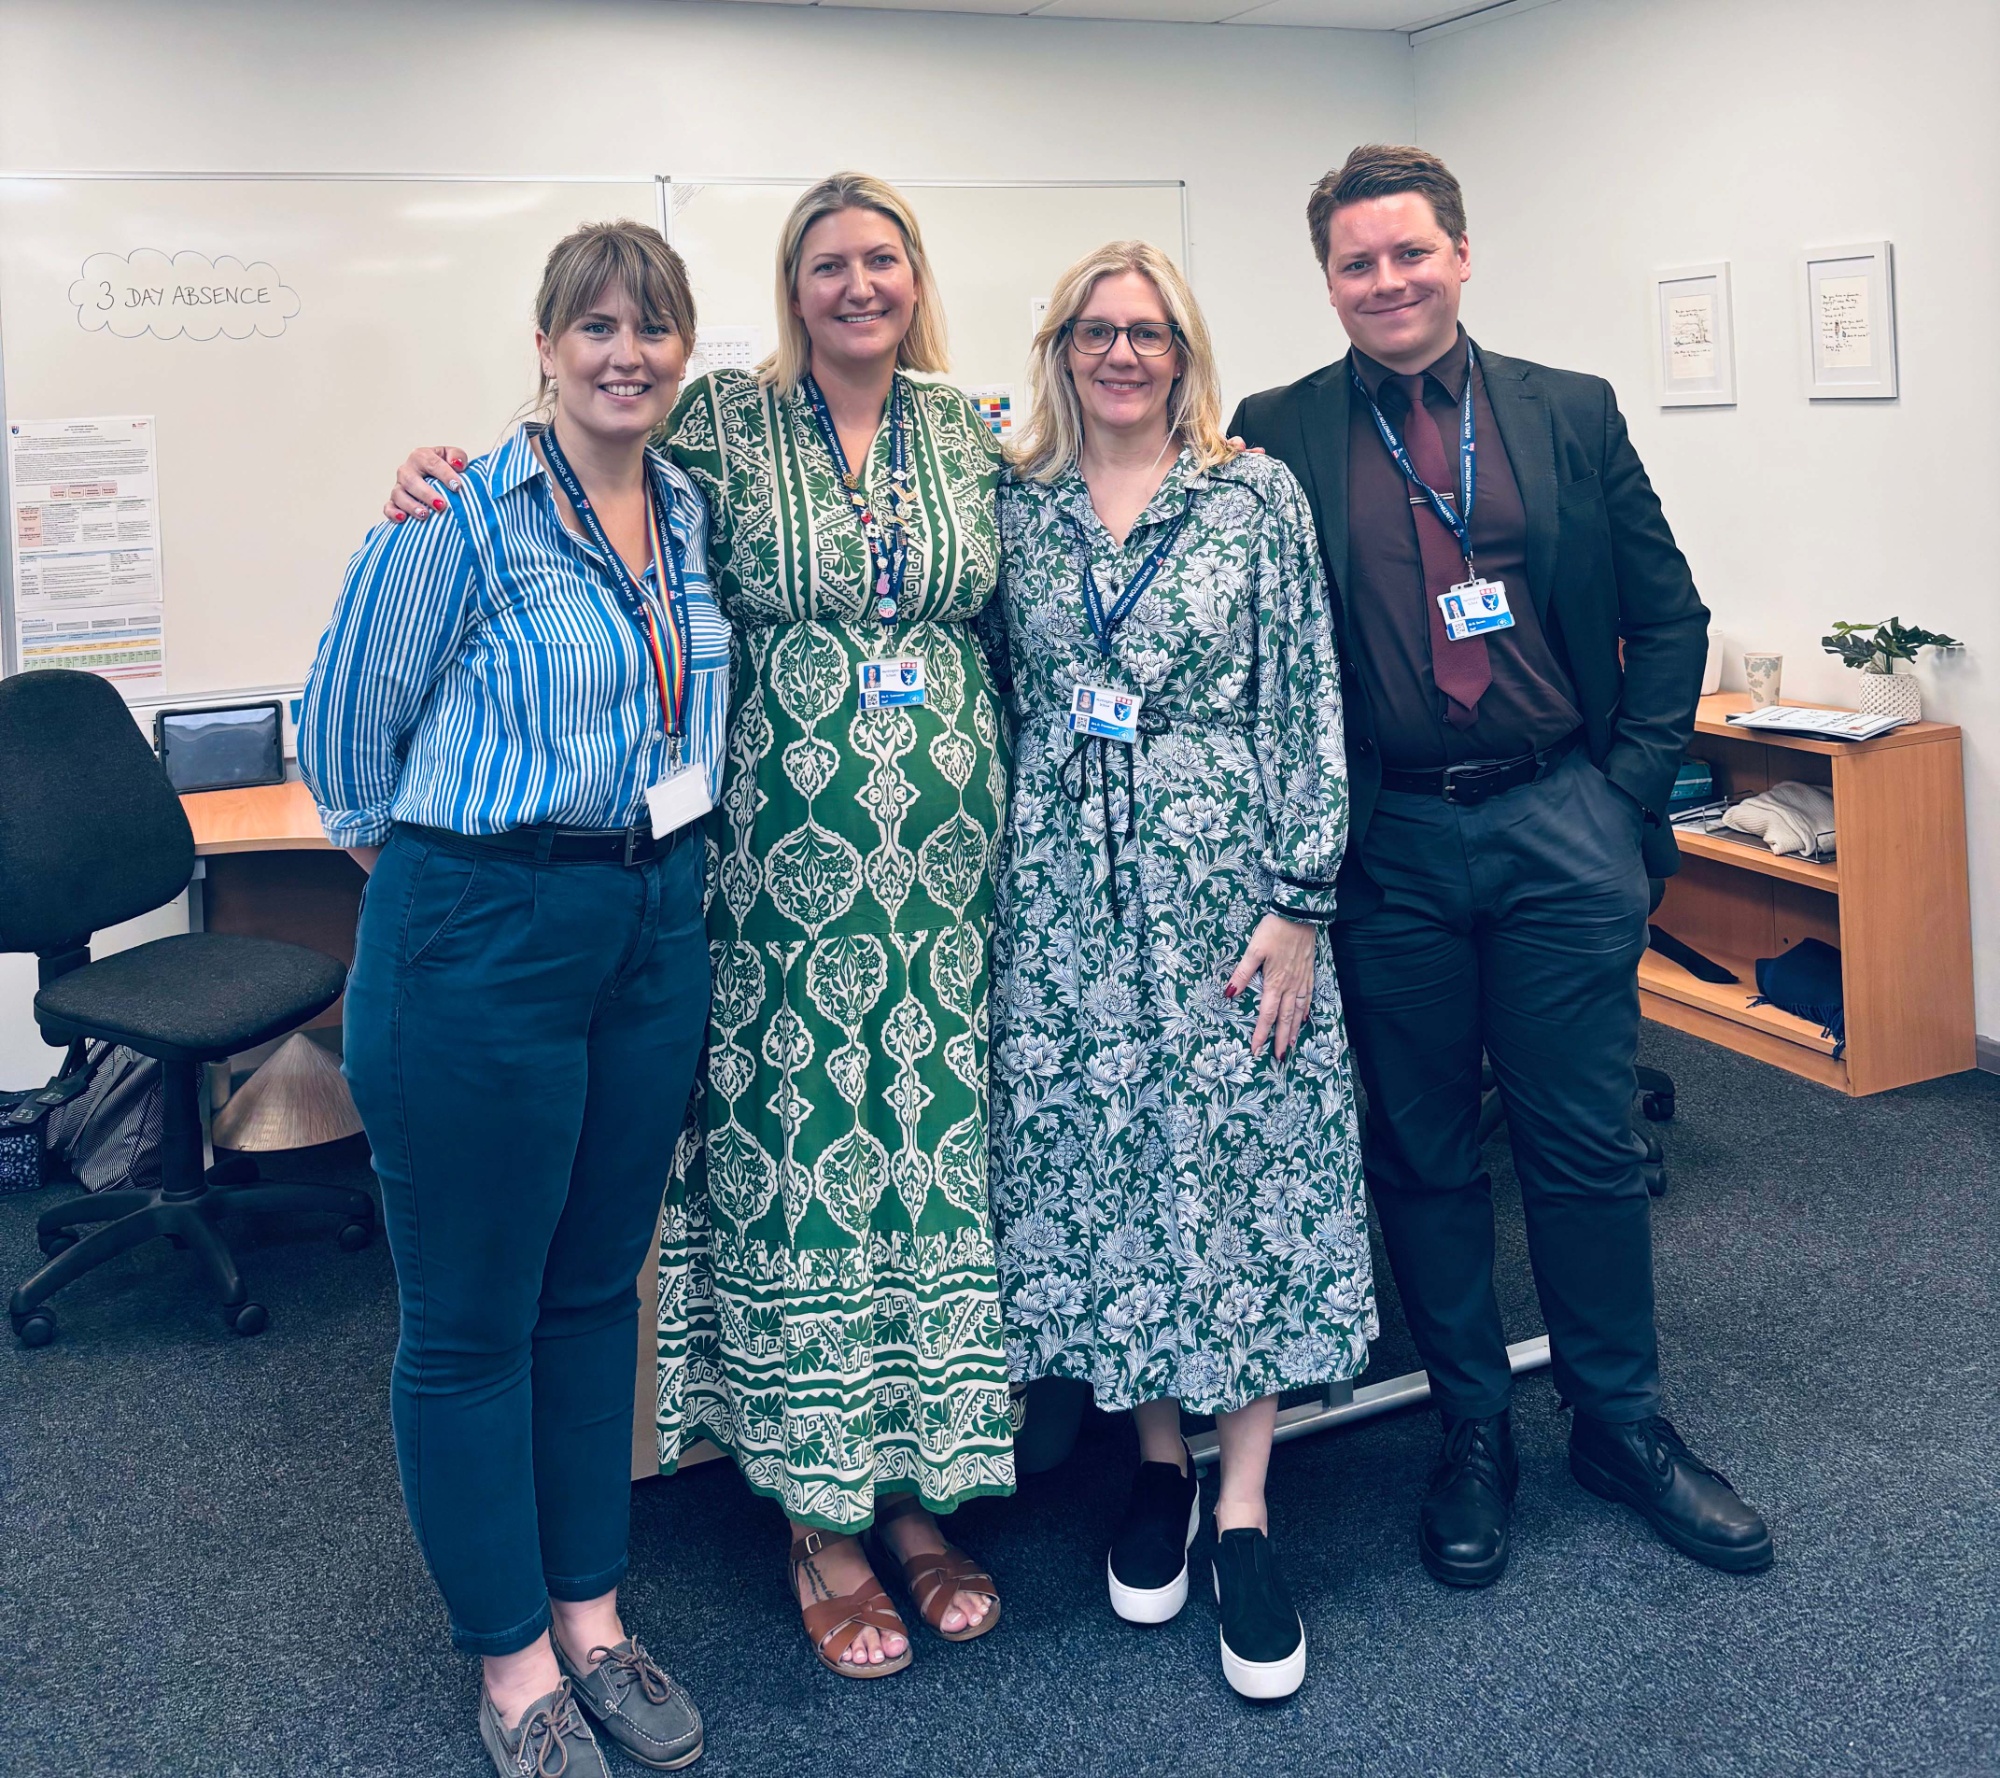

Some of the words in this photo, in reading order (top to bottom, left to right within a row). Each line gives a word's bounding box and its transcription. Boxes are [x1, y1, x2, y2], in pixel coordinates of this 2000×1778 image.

[96, 281, 115, 310] 3
[125, 288, 164, 308] DAY
[172, 286, 271, 306] ABSENCE
[550, 449, 567, 478] SCHOOL
[564, 476, 580, 496] STAFF
[584, 513, 609, 555] HUNTINGTON
[607, 553, 625, 582] SCHOOL
[620, 580, 635, 602] STAFF
[664, 545, 678, 586] HUNTINGTON
[1128, 564, 1155, 602] HUNTINGTON
[676, 604, 685, 625] STAFF
[1088, 591, 1103, 632] HUNTINGTON
[1112, 596, 1133, 623] SCHOOL
